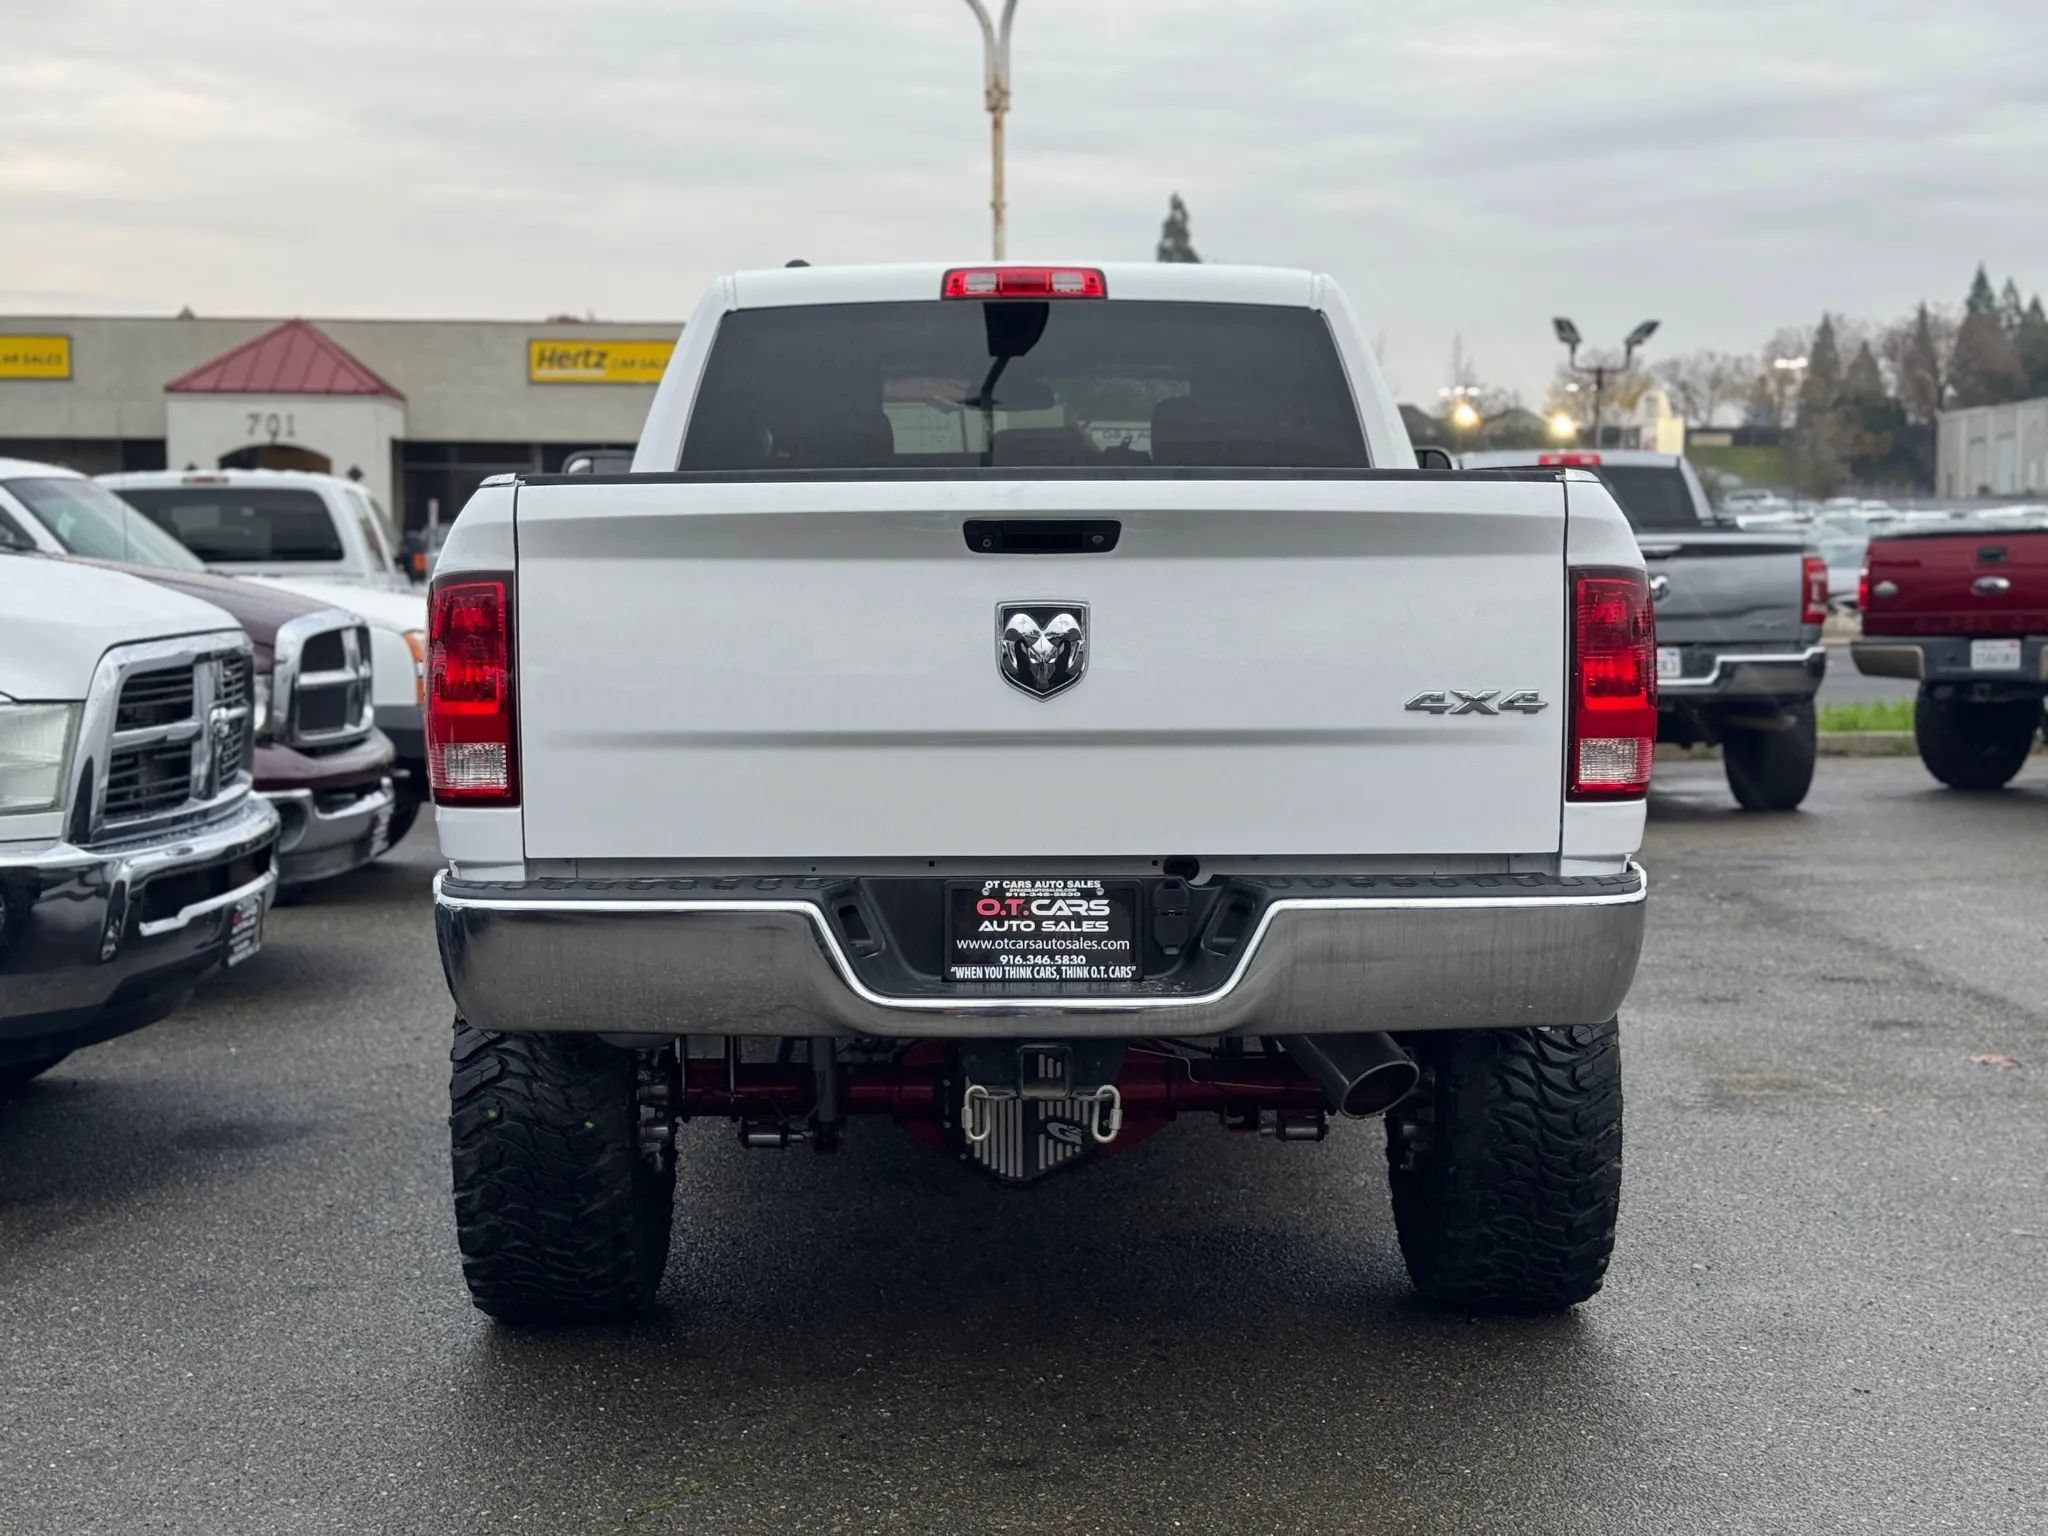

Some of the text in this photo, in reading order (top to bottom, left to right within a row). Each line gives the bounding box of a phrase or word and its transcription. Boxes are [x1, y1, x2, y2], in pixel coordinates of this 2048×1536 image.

[537, 347, 608, 369] Hertz
[246, 412, 296, 438] 701
[1404, 690, 1549, 715] 4X4
[985, 880, 1101, 889] OT CARS AUTO SALES
[978, 920, 1109, 932] AUTO SALES
[956, 937, 1130, 950] www.otcarsautosales.com
[1000, 955, 1086, 965] 916.346.5830
[985, 966, 1002, 979] YOU
[1004, 966, 1032, 979] THINK
[1034, 966, 1060, 981] CARS,
[1061, 966, 1089, 979] THINK
[1090, 966, 1107, 979] O.T.
